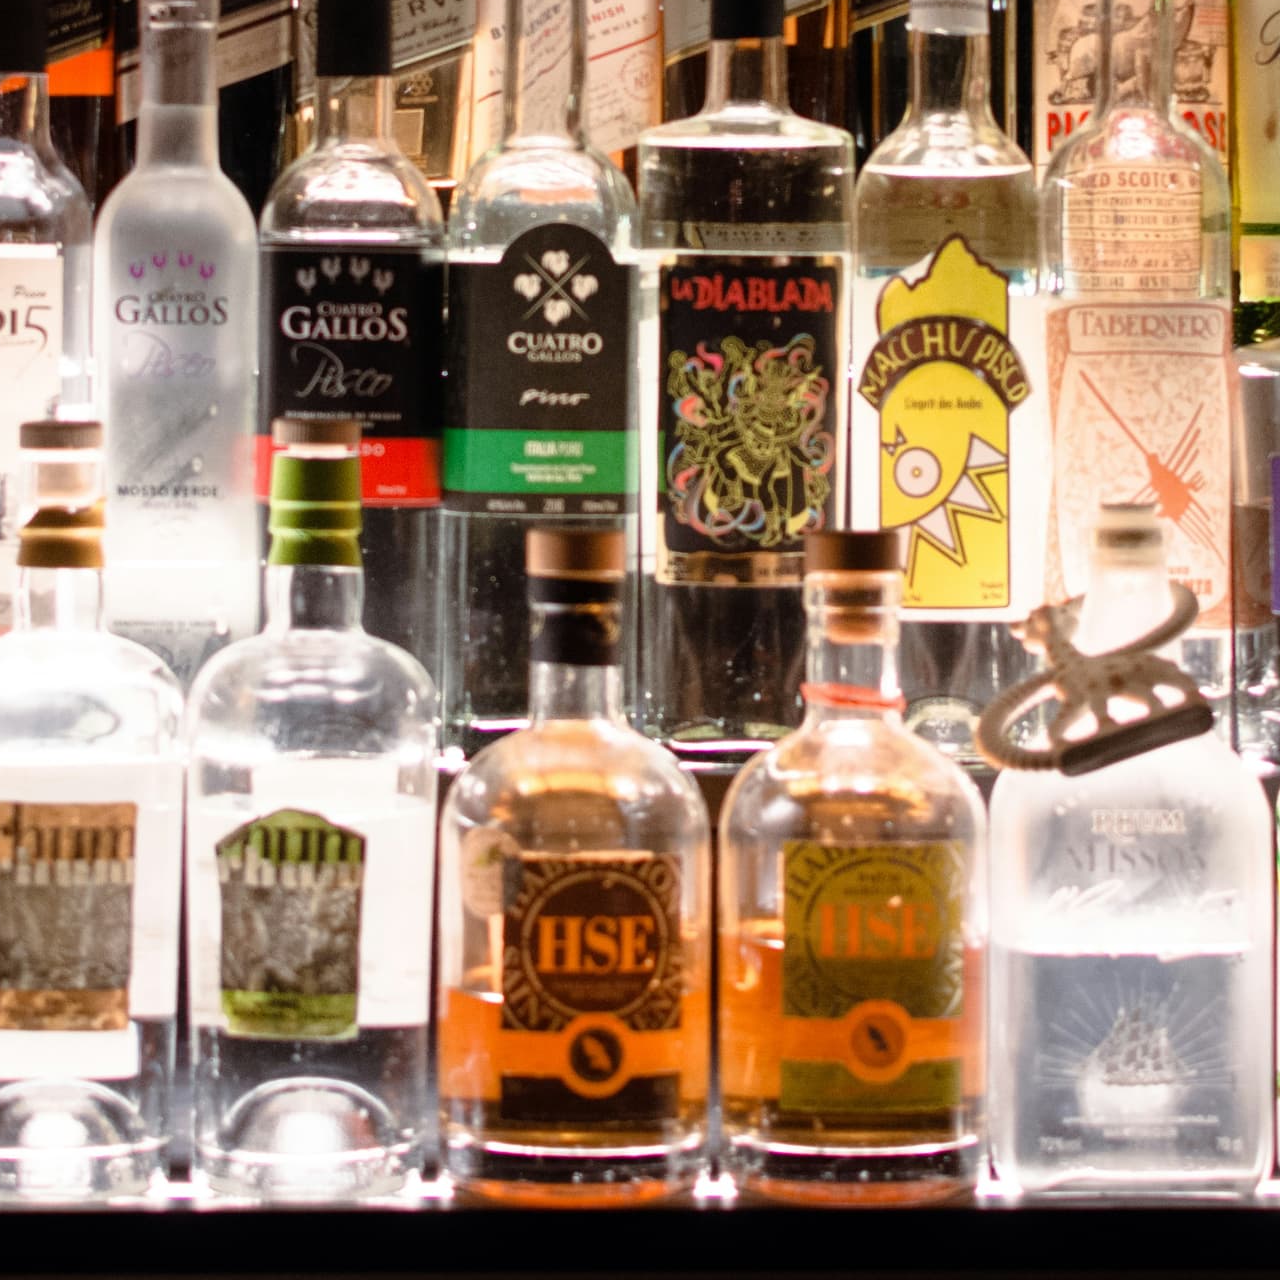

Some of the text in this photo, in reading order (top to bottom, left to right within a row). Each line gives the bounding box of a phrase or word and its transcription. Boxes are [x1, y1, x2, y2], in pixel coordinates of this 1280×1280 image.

[115, 294, 229, 326] GALLOS
[281, 305, 408, 341] GALLOS
[318, 302, 382, 316] CUATRO
[507, 332, 603, 355] CUATRO
[527, 351, 581, 362] GALLOS
[860, 322, 1028, 404] MACCHU PISCO
[537, 916, 655, 973] HSE
[820, 905, 934, 958] HSE
